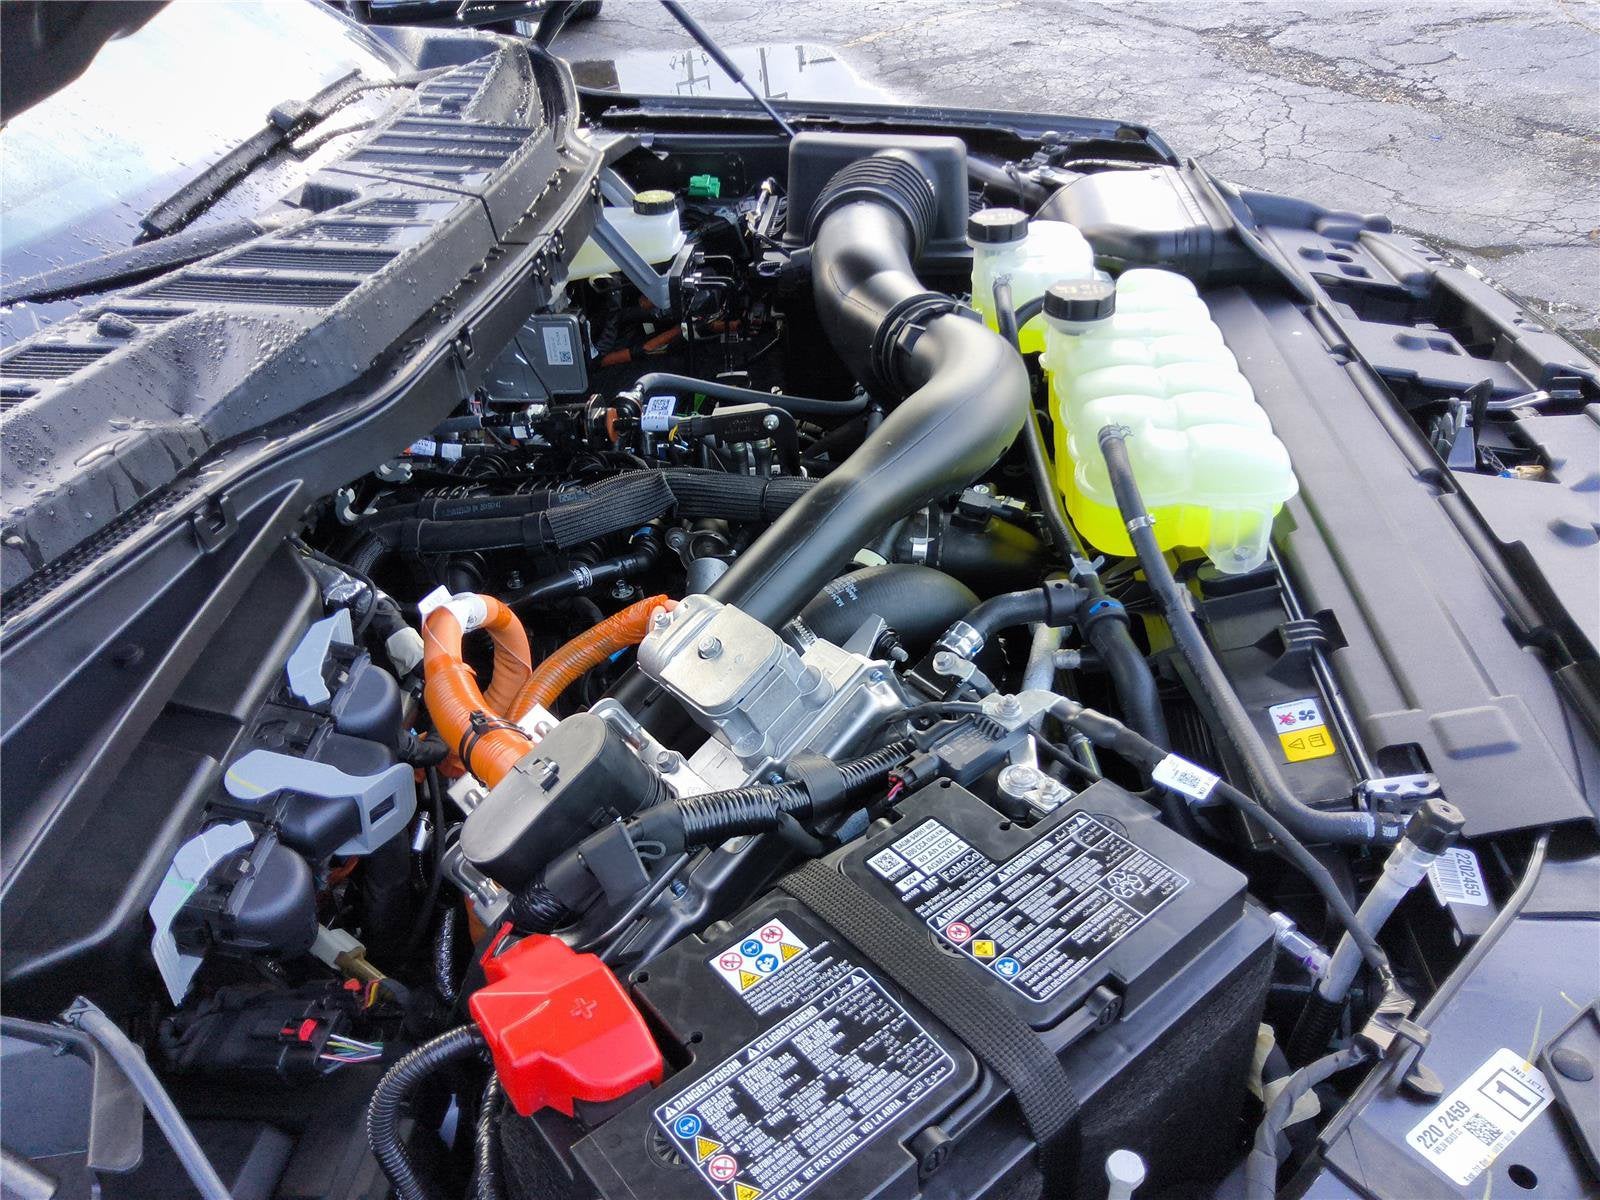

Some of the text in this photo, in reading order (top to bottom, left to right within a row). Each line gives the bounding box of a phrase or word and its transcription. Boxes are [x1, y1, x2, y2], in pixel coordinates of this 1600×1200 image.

[915, 840, 928, 850] CCA
[927, 847, 938, 856] Ah
[938, 838, 952, 848] C20
[926, 844, 965, 871] AGM/VRLA
[942, 852, 980, 878] FoMoCo
[903, 875, 918, 886] 12V
[920, 876, 942, 892] MF
[941, 881, 997, 920] DANGER/POISON
[1003, 841, 1054, 876] PELIGRO/VENENO
[1456, 852, 1482, 897] 2202459
[1071, 923, 1093, 941] CONTRA
[1019, 948, 1060, 983] NON-SPILLABLE
[1025, 974, 1040, 986] Lead
[1037, 965, 1051, 976] Acid
[1038, 985, 1053, 998] ANTI
[673, 1059, 743, 1110] DANGER/POISON
[755, 1005, 819, 1052] PELIGRO/VENENO
[737, 1074, 748, 1083] SE
[743, 1079, 755, 1089] LES
[768, 1060, 781, 1070] LES
[778, 1052, 792, 1063] GAZ
[771, 1076, 784, 1087] DES
[784, 1078, 794, 1086] ET
[791, 1073, 801, 1082] LA
[828, 1071, 838, 1079] NO
[696, 1084, 734, 1113] SHIELD EYES.
[789, 1099, 800, 1109] LES
[1495, 1080, 1532, 1107] 1
[701, 1094, 733, 1119] EXPLOSIVE
[706, 1101, 738, 1125] GASES CAN
[794, 1105, 805, 1114] LES
[711, 1115, 731, 1131] CAUSE
[716, 1113, 746, 1137] BLINDNESS
[721, 1119, 751, 1142] OR INJURY.
[1416, 1124, 1445, 1150] 220
[1438, 1100, 1471, 1130] 2459
[742, 1127, 762, 1143] SPARKS
[747, 1133, 768, 1150] FLAMES
[730, 1144, 741, 1153] NO
[749, 1140, 796, 1176] SULFURIC ACID CAN
[777, 1097, 905, 1199] OPEN. NE PAS OUVRIR. NO LA ABRA.
[756, 1149, 799, 1183] CAUSE BLINDNESS
